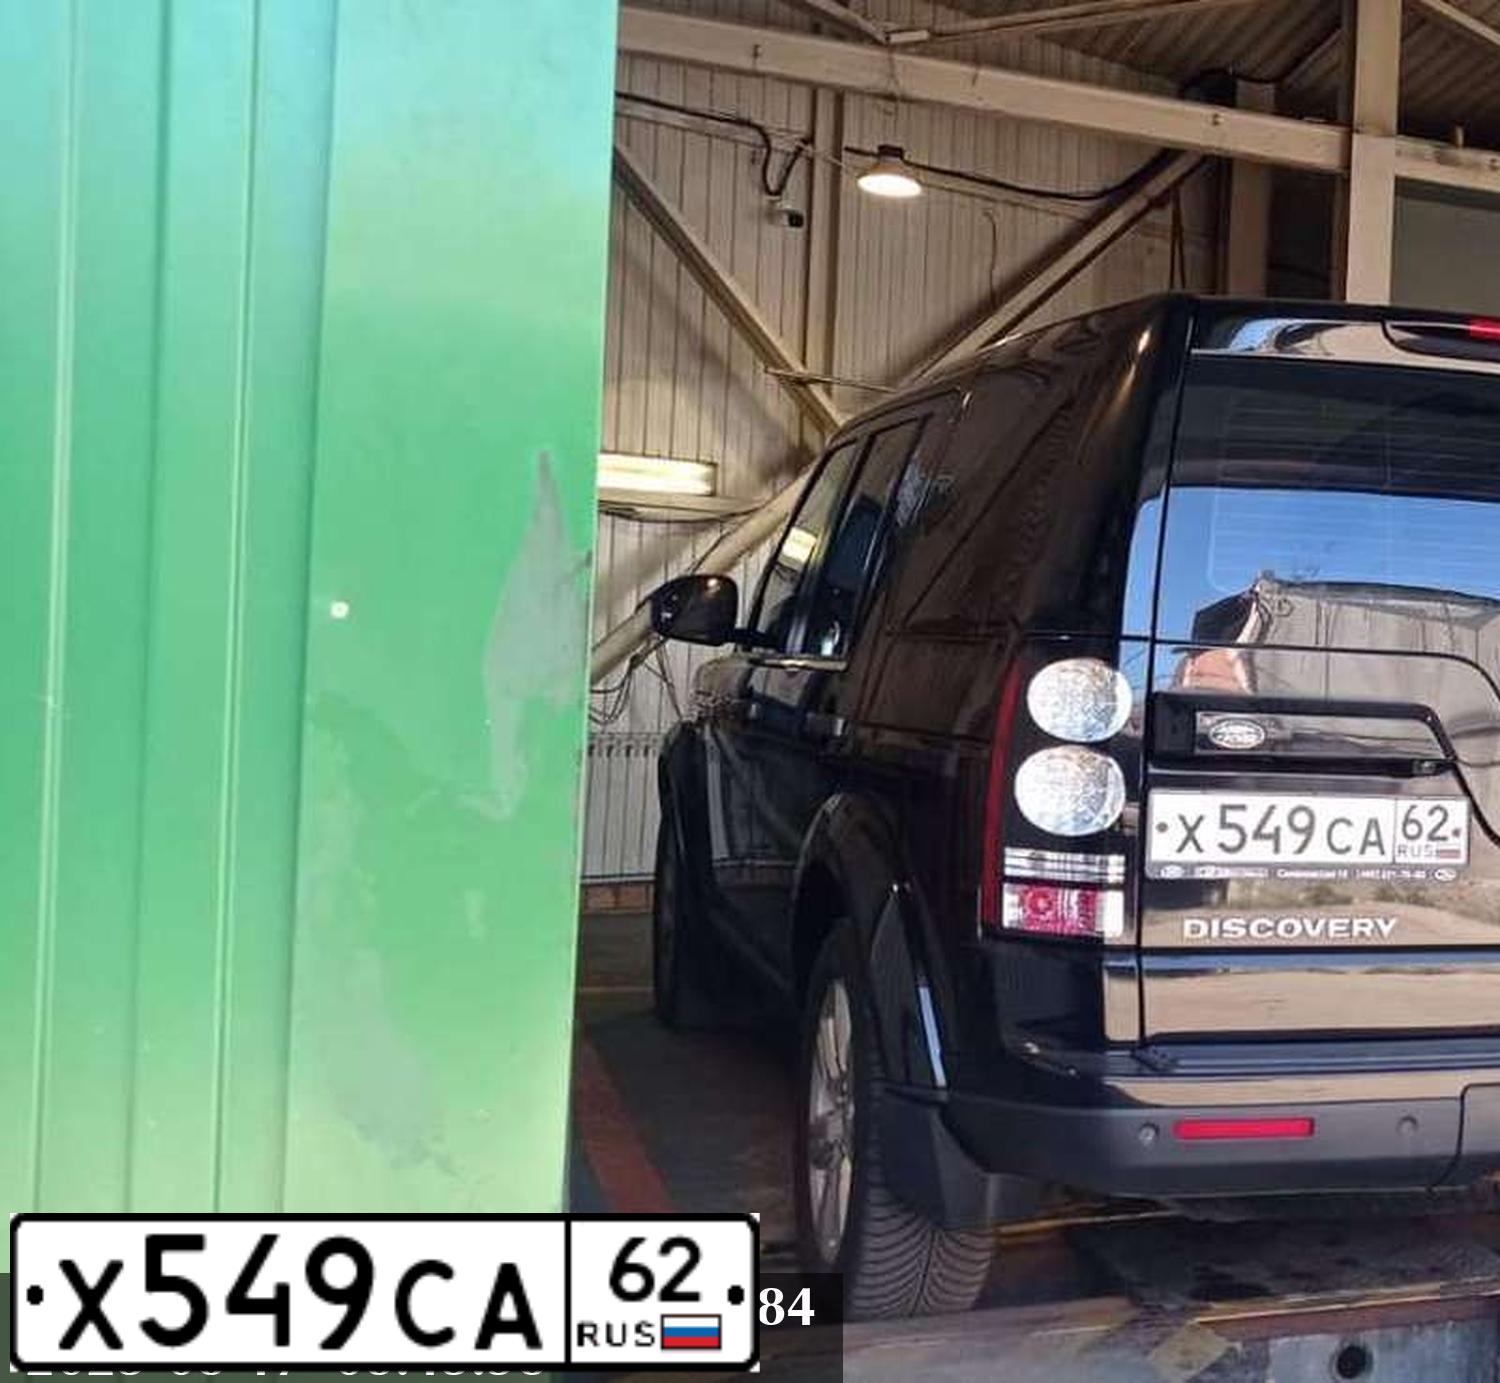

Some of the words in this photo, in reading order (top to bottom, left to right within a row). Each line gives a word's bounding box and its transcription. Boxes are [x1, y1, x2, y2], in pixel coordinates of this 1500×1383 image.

[1401, 804, 1449, 842] 62
[1397, 844, 1437, 858] RUS
[1183, 917, 1397, 939] DISCOVERY
